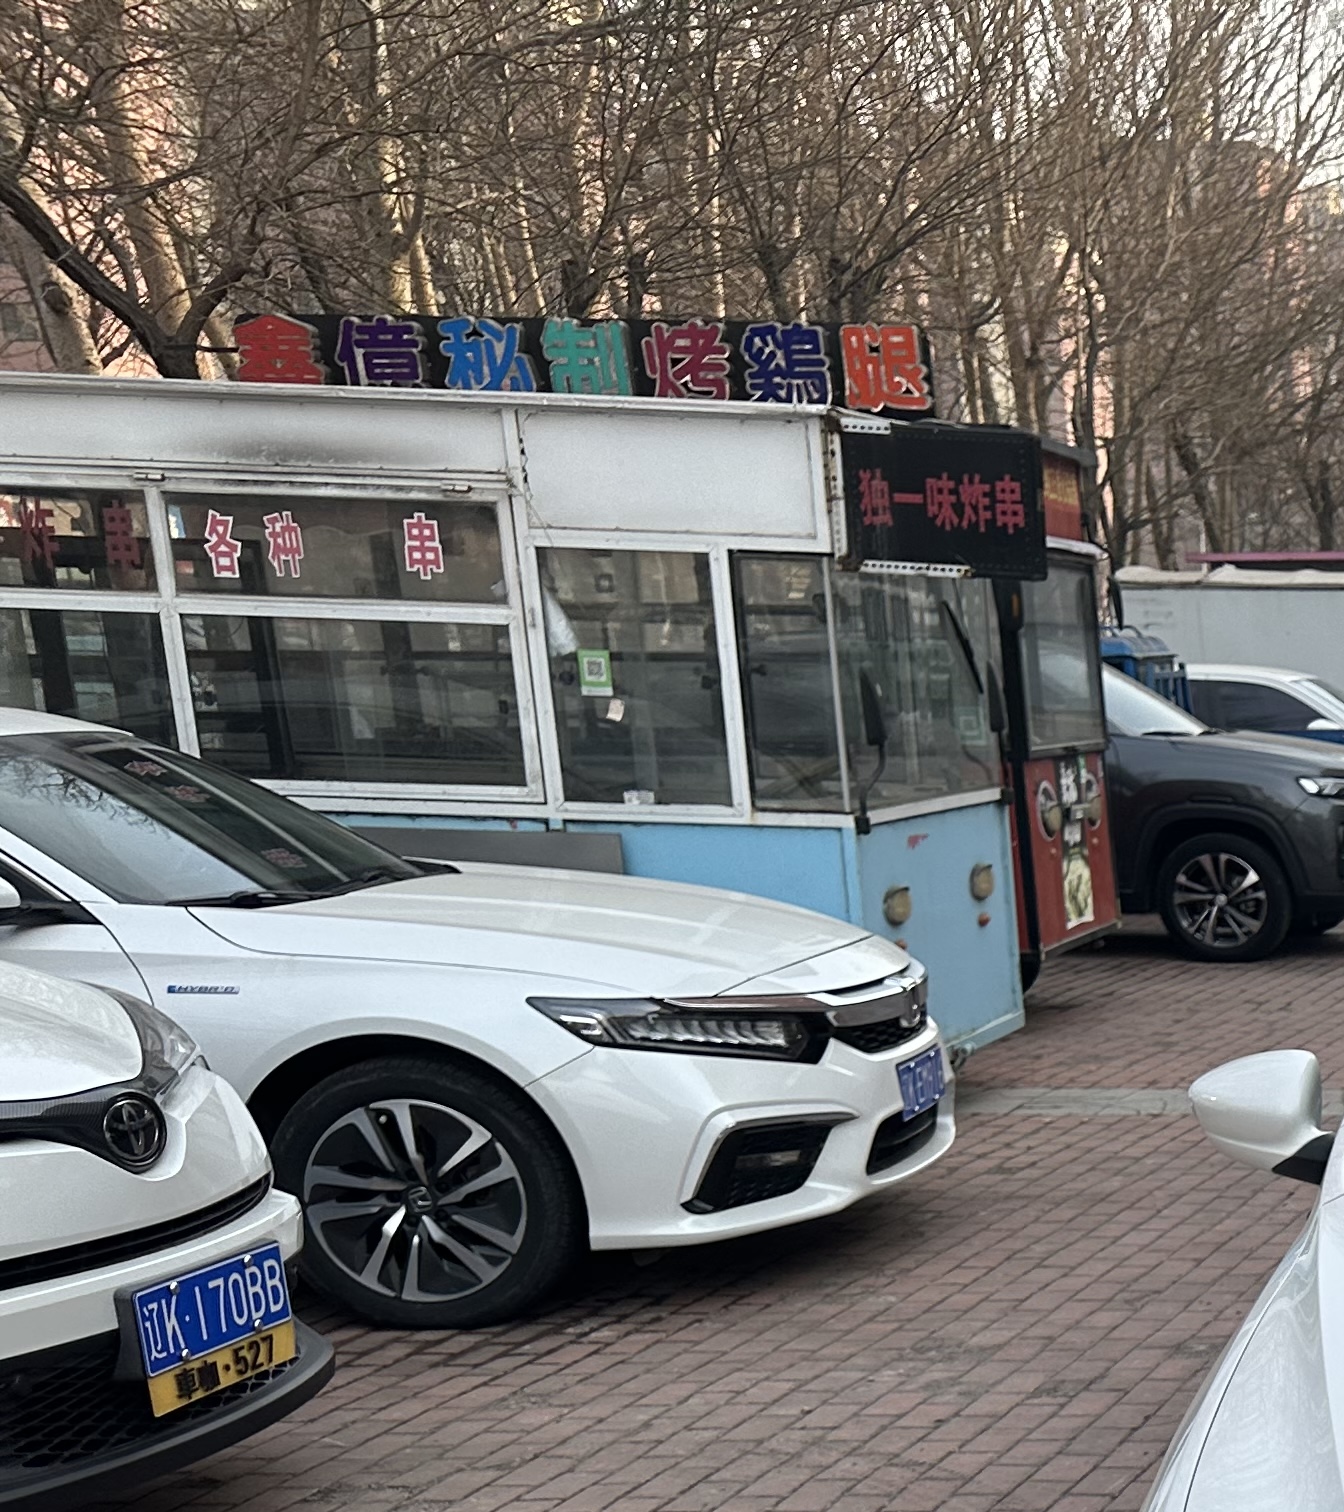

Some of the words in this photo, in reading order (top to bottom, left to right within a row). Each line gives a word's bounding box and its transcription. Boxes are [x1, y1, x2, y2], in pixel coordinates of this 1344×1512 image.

[858, 468, 1025, 534] 独一味炸串
